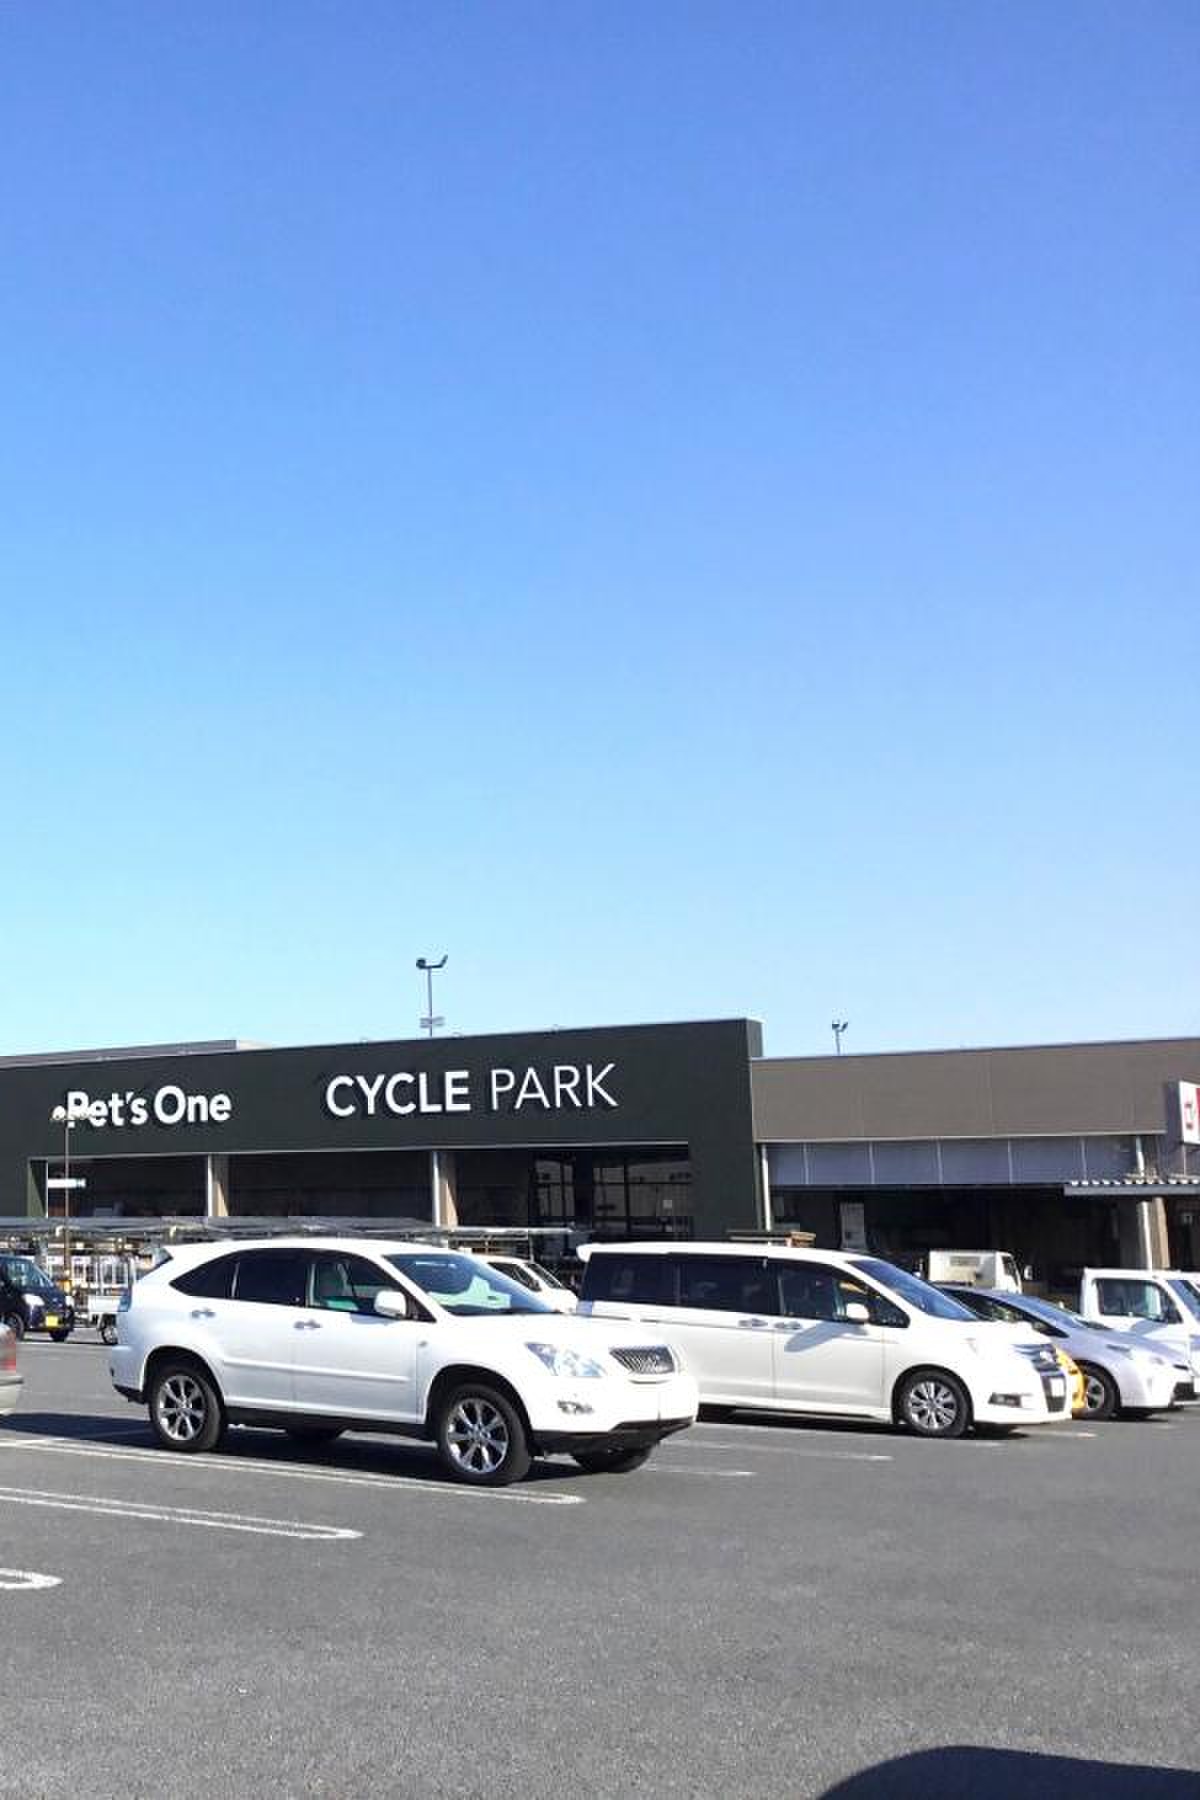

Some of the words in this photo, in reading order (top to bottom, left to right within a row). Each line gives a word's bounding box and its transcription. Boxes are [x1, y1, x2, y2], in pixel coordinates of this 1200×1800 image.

[67, 1091, 148, 1128] Pet's
[153, 1085, 232, 1125] One
[326, 1069, 472, 1117] CYCLE
[490, 1063, 619, 1111] PARK
